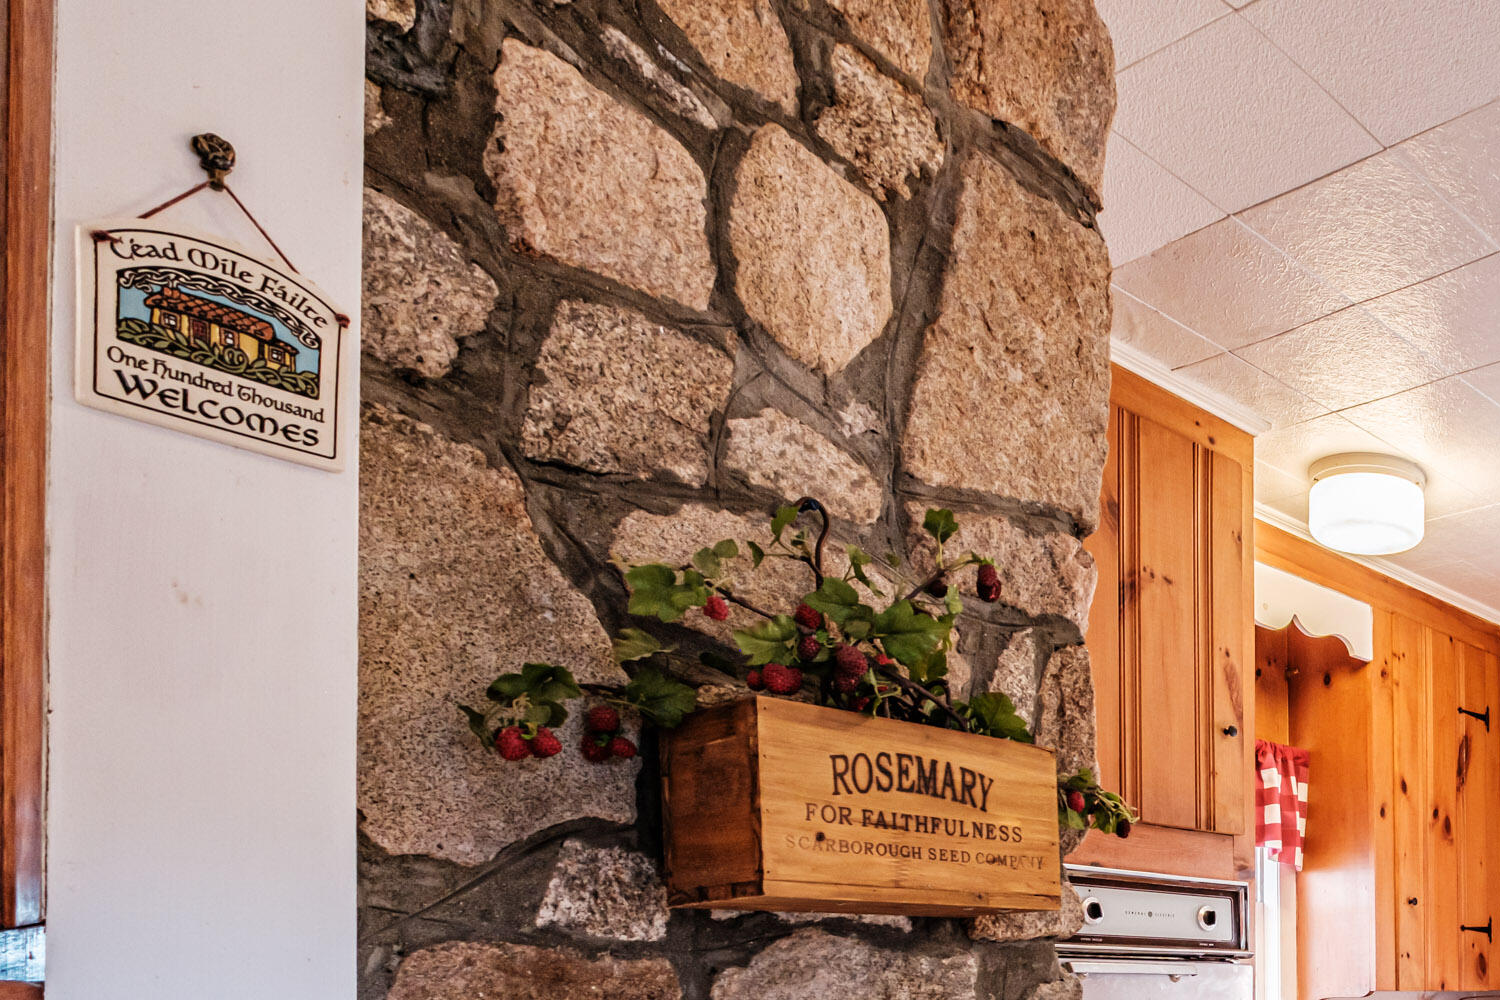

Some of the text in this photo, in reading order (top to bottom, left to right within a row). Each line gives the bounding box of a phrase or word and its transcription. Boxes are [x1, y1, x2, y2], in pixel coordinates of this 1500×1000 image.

[256, 274, 328, 329] Fáilte
[107, 345, 325, 423] One Hundred Thousand
[113, 369, 319, 446] WELCOMES
[829, 752, 994, 812] ROSEMARY
[785, 833, 922, 860] SCARBOROUGH
[928, 848, 971, 864] SEED
[805, 802, 1023, 843] FOR FAITHFULNESS
